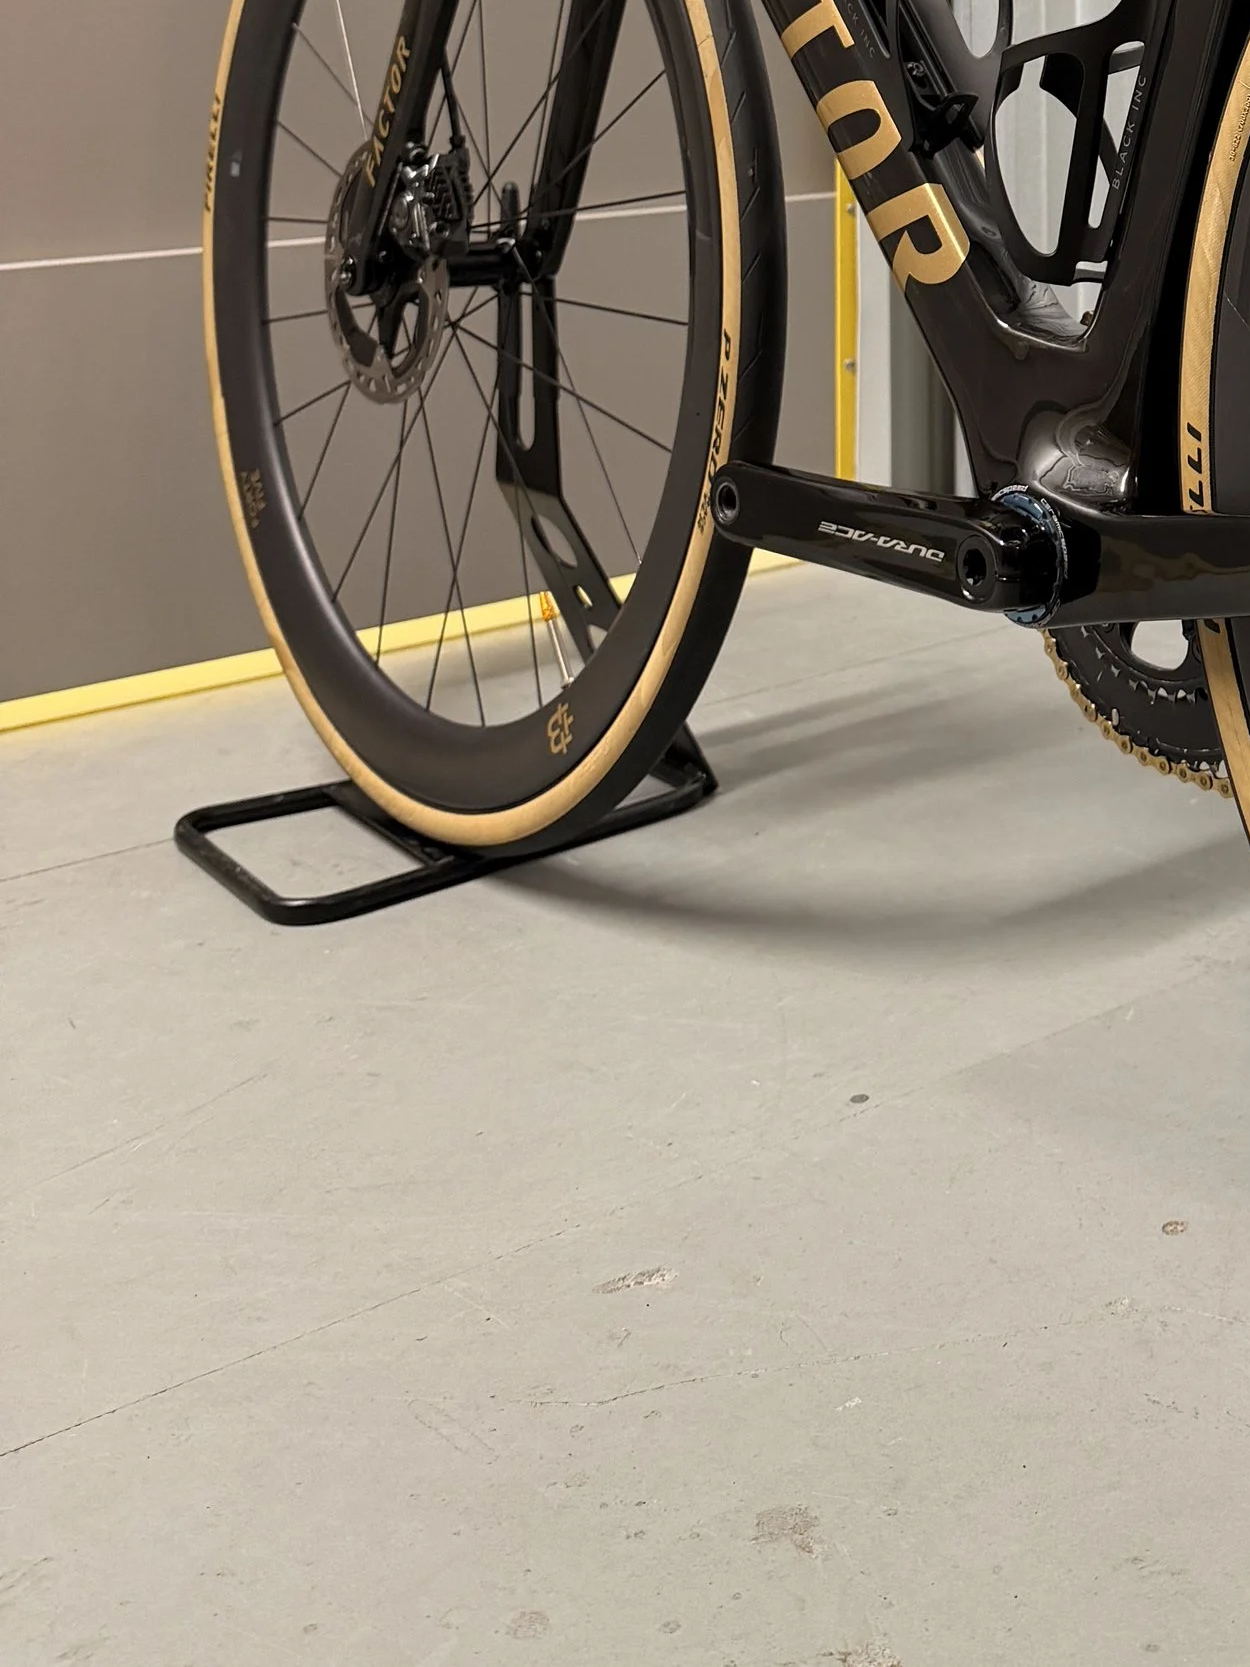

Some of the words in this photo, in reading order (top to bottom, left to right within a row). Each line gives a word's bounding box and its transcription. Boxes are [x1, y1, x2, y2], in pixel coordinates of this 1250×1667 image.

[364, 36, 414, 189] FACTOR
[1111, 121, 1135, 191] BLACK
[1132, 75, 1147, 112] INC
[720, 328, 732, 363] P
[817, 520, 946, 564] DURA-ACE
